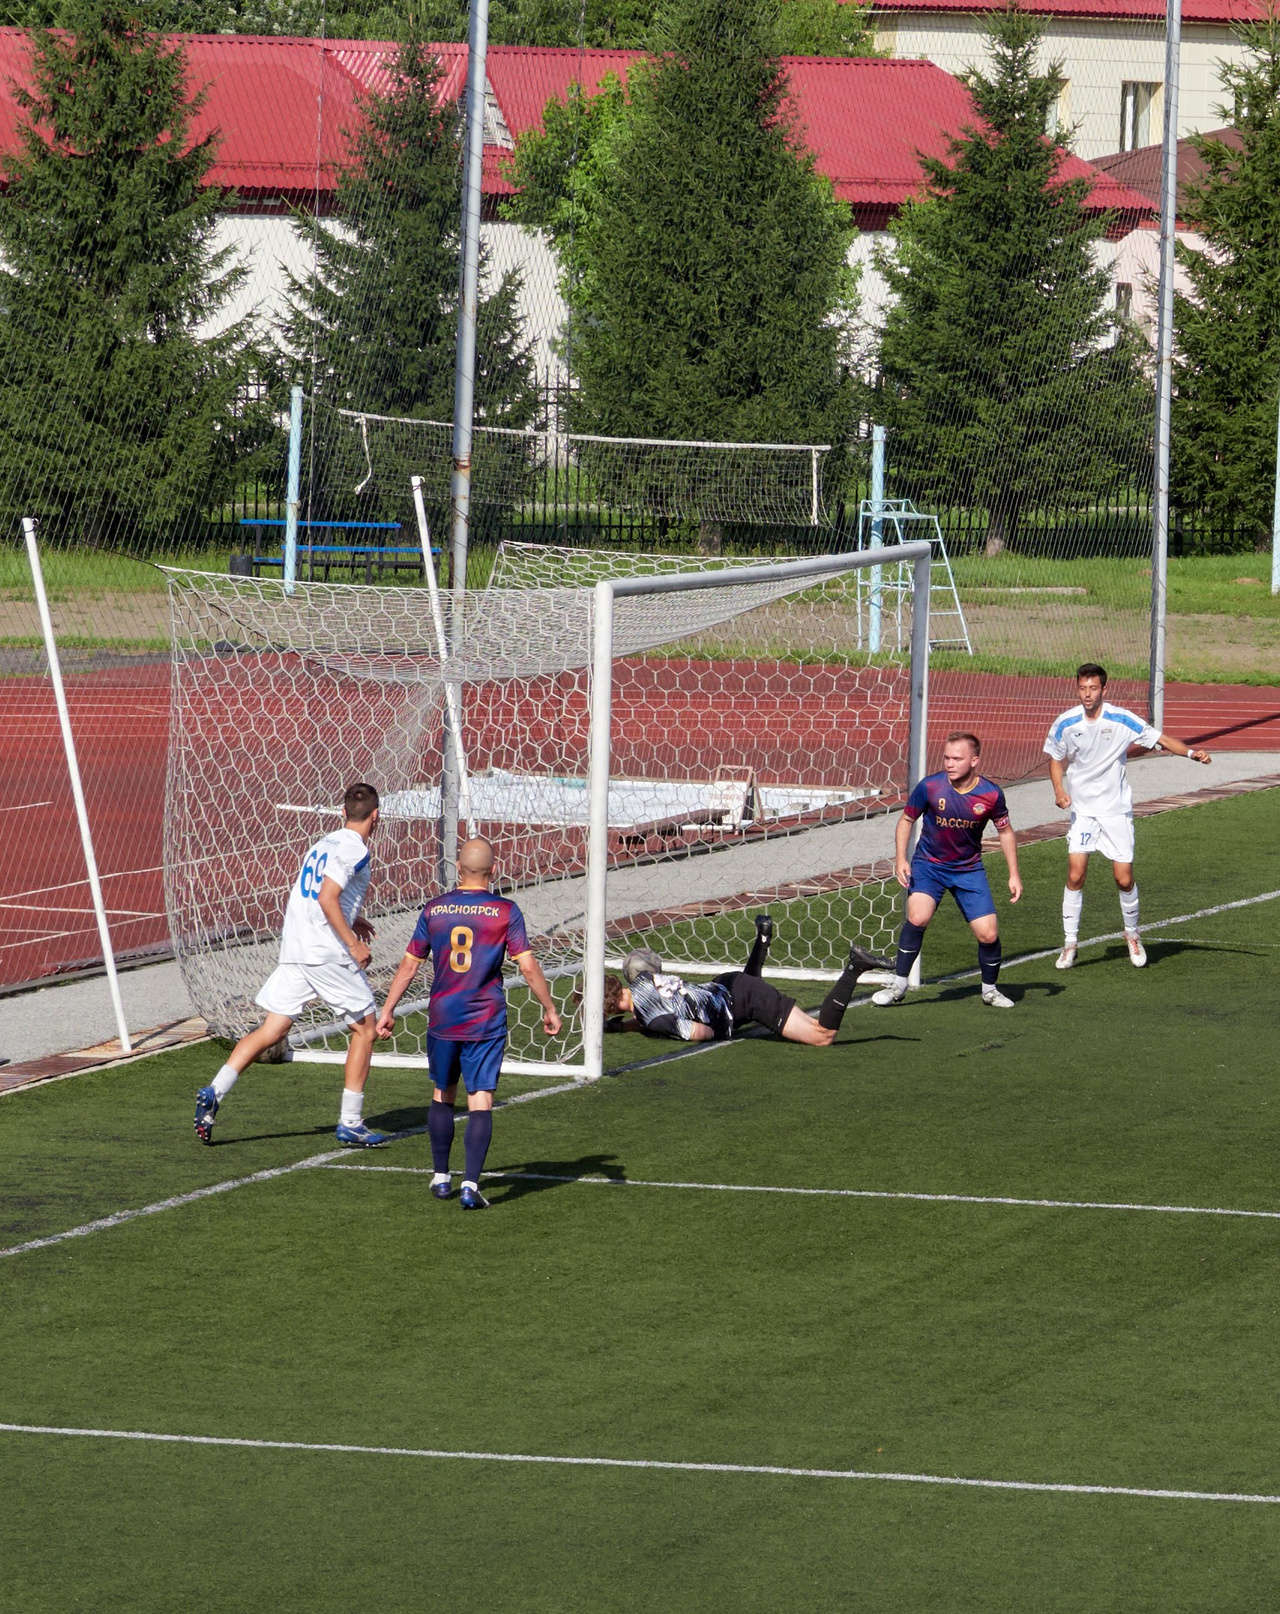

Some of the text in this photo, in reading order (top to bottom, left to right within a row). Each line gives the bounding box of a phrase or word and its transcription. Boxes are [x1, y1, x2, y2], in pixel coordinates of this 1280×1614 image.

[938, 798, 946, 811] 9
[1080, 832, 1092, 846] 17
[301, 850, 328, 899] 69
[430, 904, 500, 917] КРАСНОЯРСК
[449, 926, 474, 973] 8
